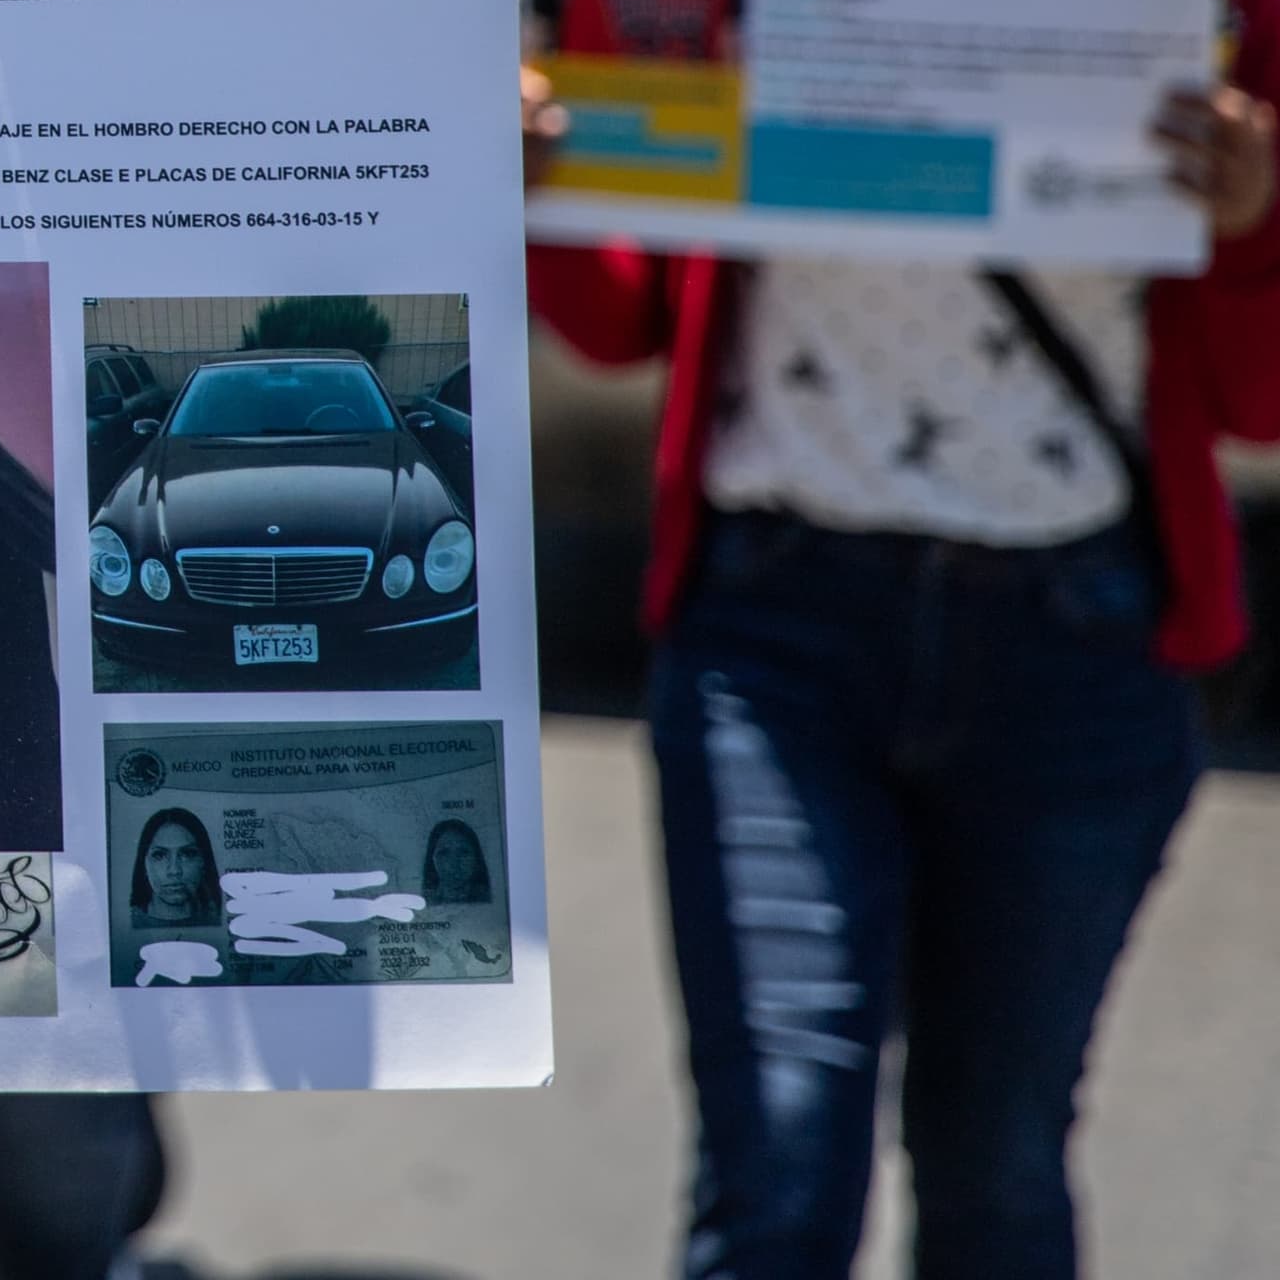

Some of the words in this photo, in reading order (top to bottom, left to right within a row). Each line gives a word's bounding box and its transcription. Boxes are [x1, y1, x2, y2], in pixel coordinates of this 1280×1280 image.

[240, 638, 313, 658] 5KFT253
[229, 746, 306, 763] INSTITUTO
[308, 743, 385, 760] NACIONAL
[387, 738, 478, 756] ELECTORAL
[171, 758, 222, 774] MÉXICO
[230, 764, 313, 779] CREDENCIAL
[314, 762, 350, 775] PARA
[353, 759, 396, 773] VOTAR
